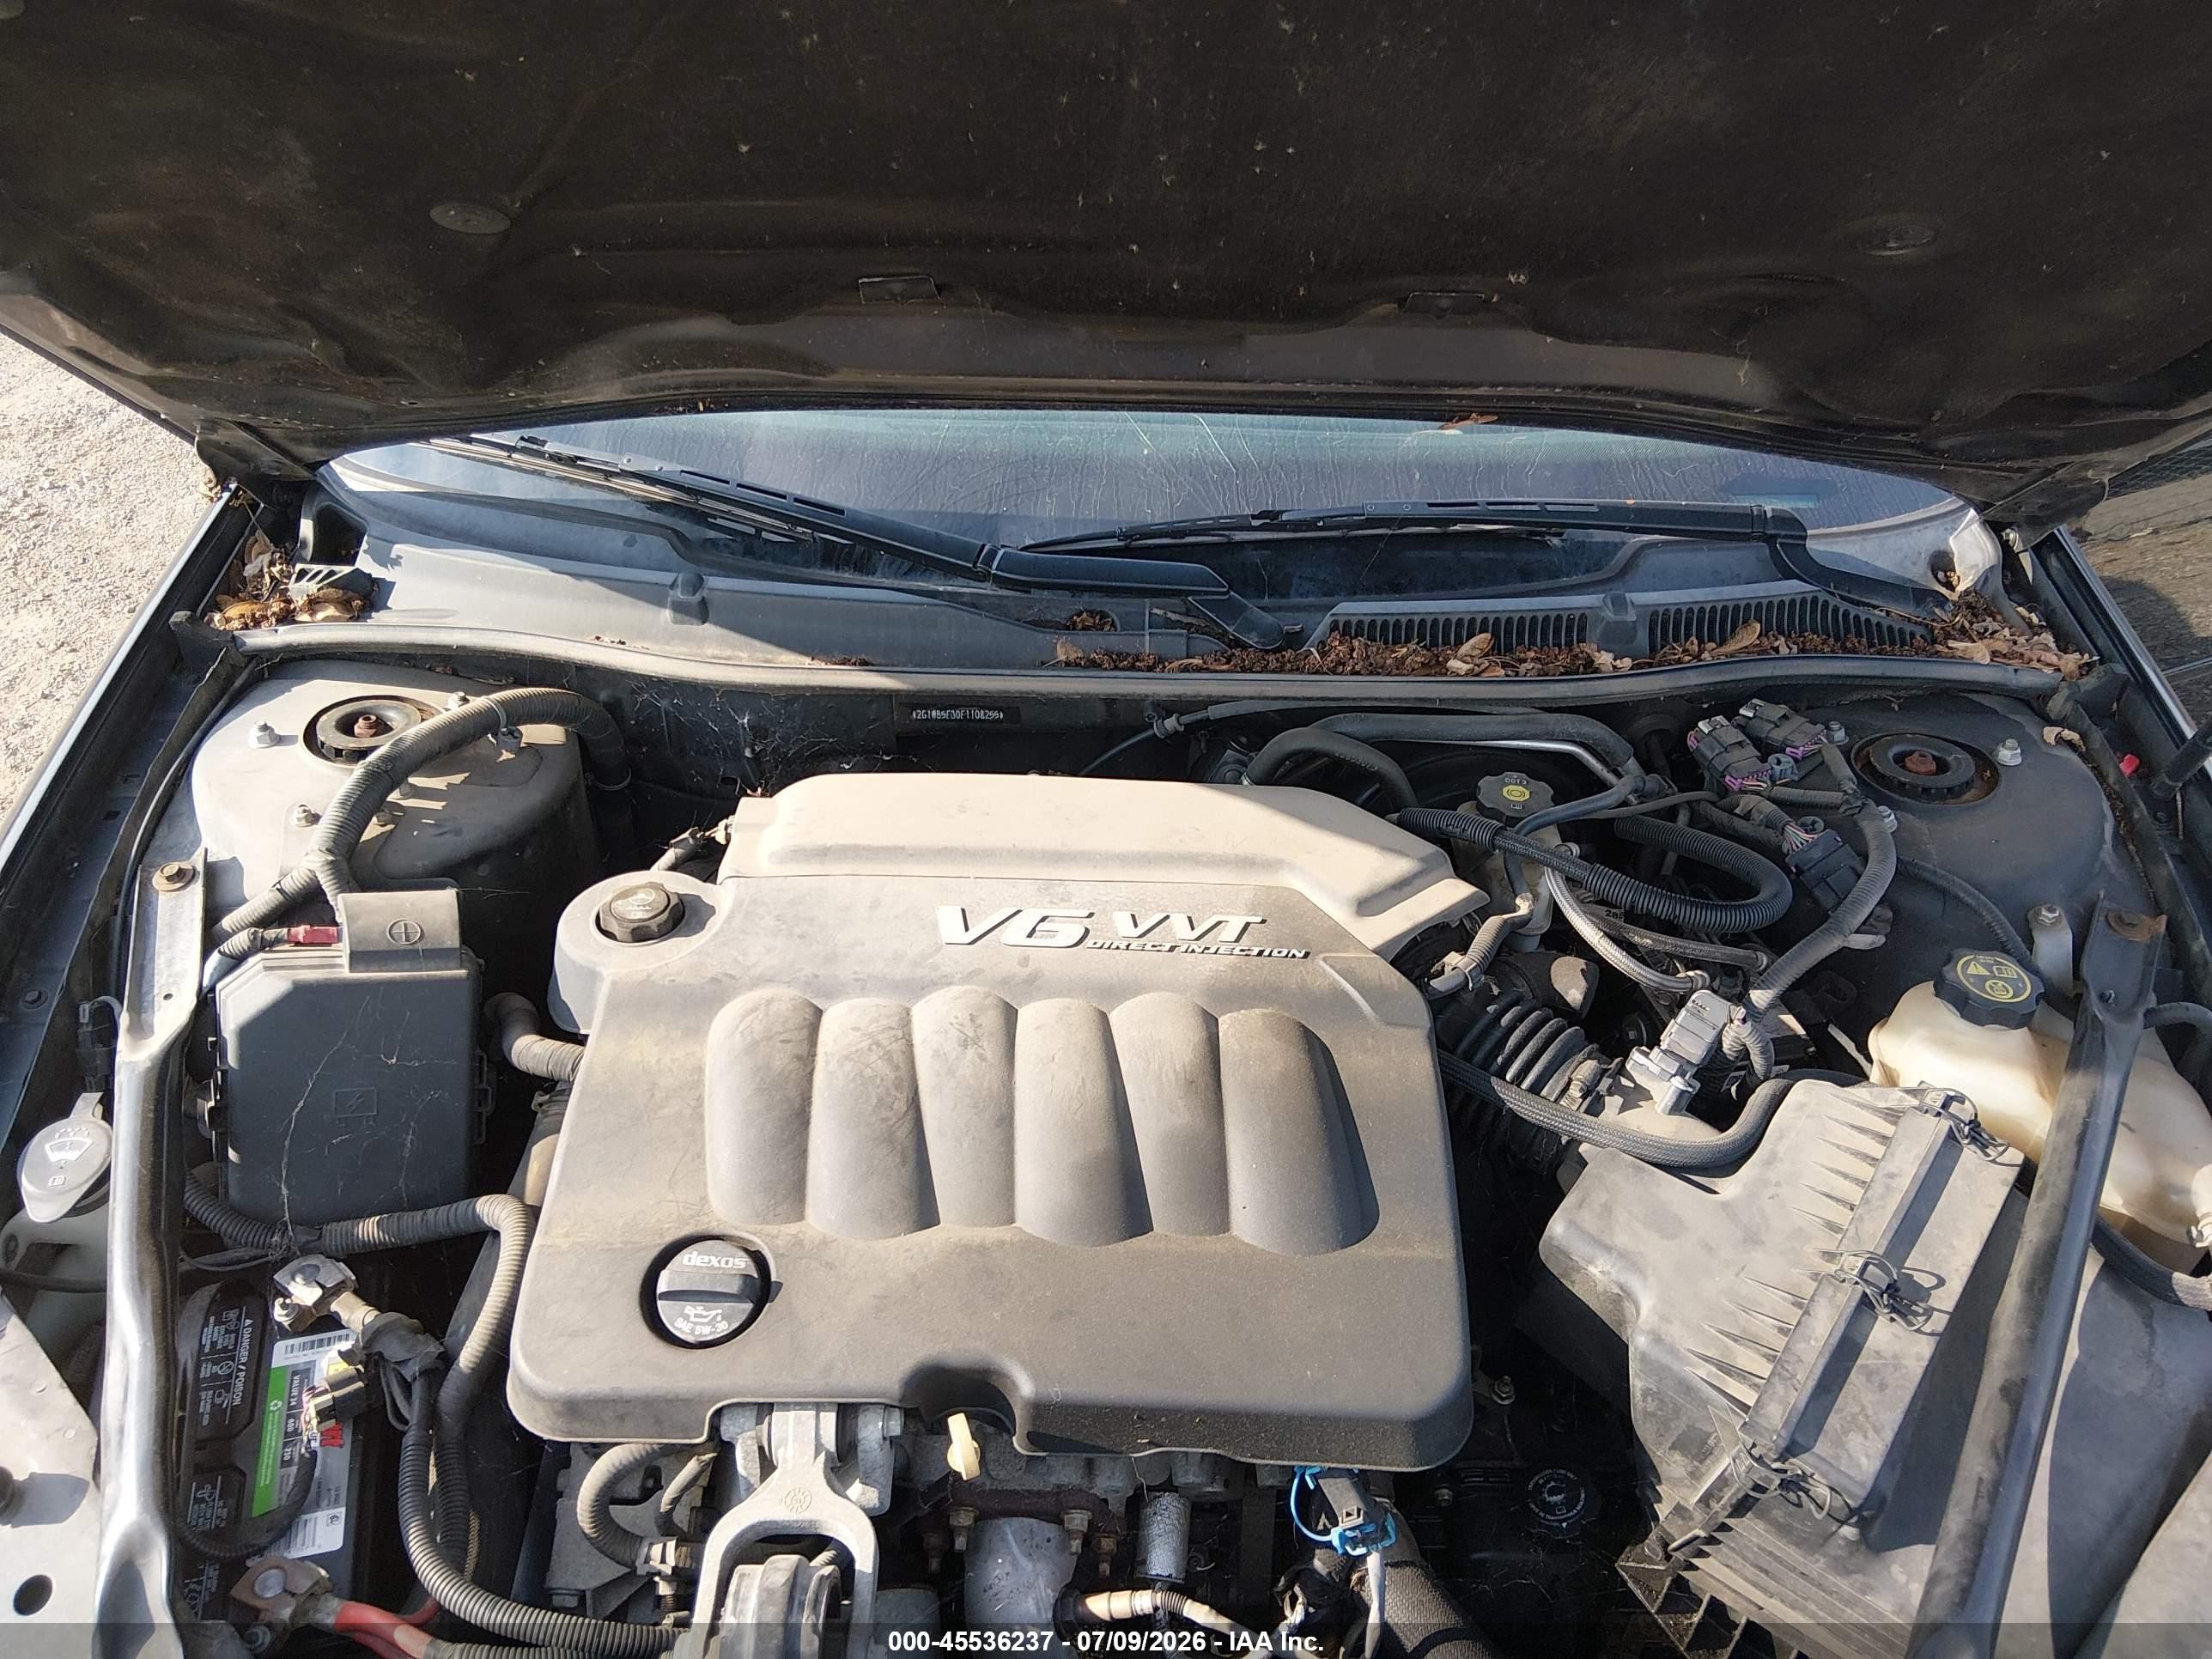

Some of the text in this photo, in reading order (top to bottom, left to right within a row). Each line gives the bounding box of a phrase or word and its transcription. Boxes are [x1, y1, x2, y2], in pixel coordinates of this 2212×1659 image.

[937, 905, 1267, 948] V6 VVT
[1086, 940, 1311, 959] DIRECT INJECTION
[683, 1251, 749, 1269] dexos
[674, 1317, 728, 1334] SAE 5W-30
[239, 1327, 252, 1364] DANGER
[232, 1371, 246, 1407] POISON
[291, 1374, 301, 1397] VALUE
